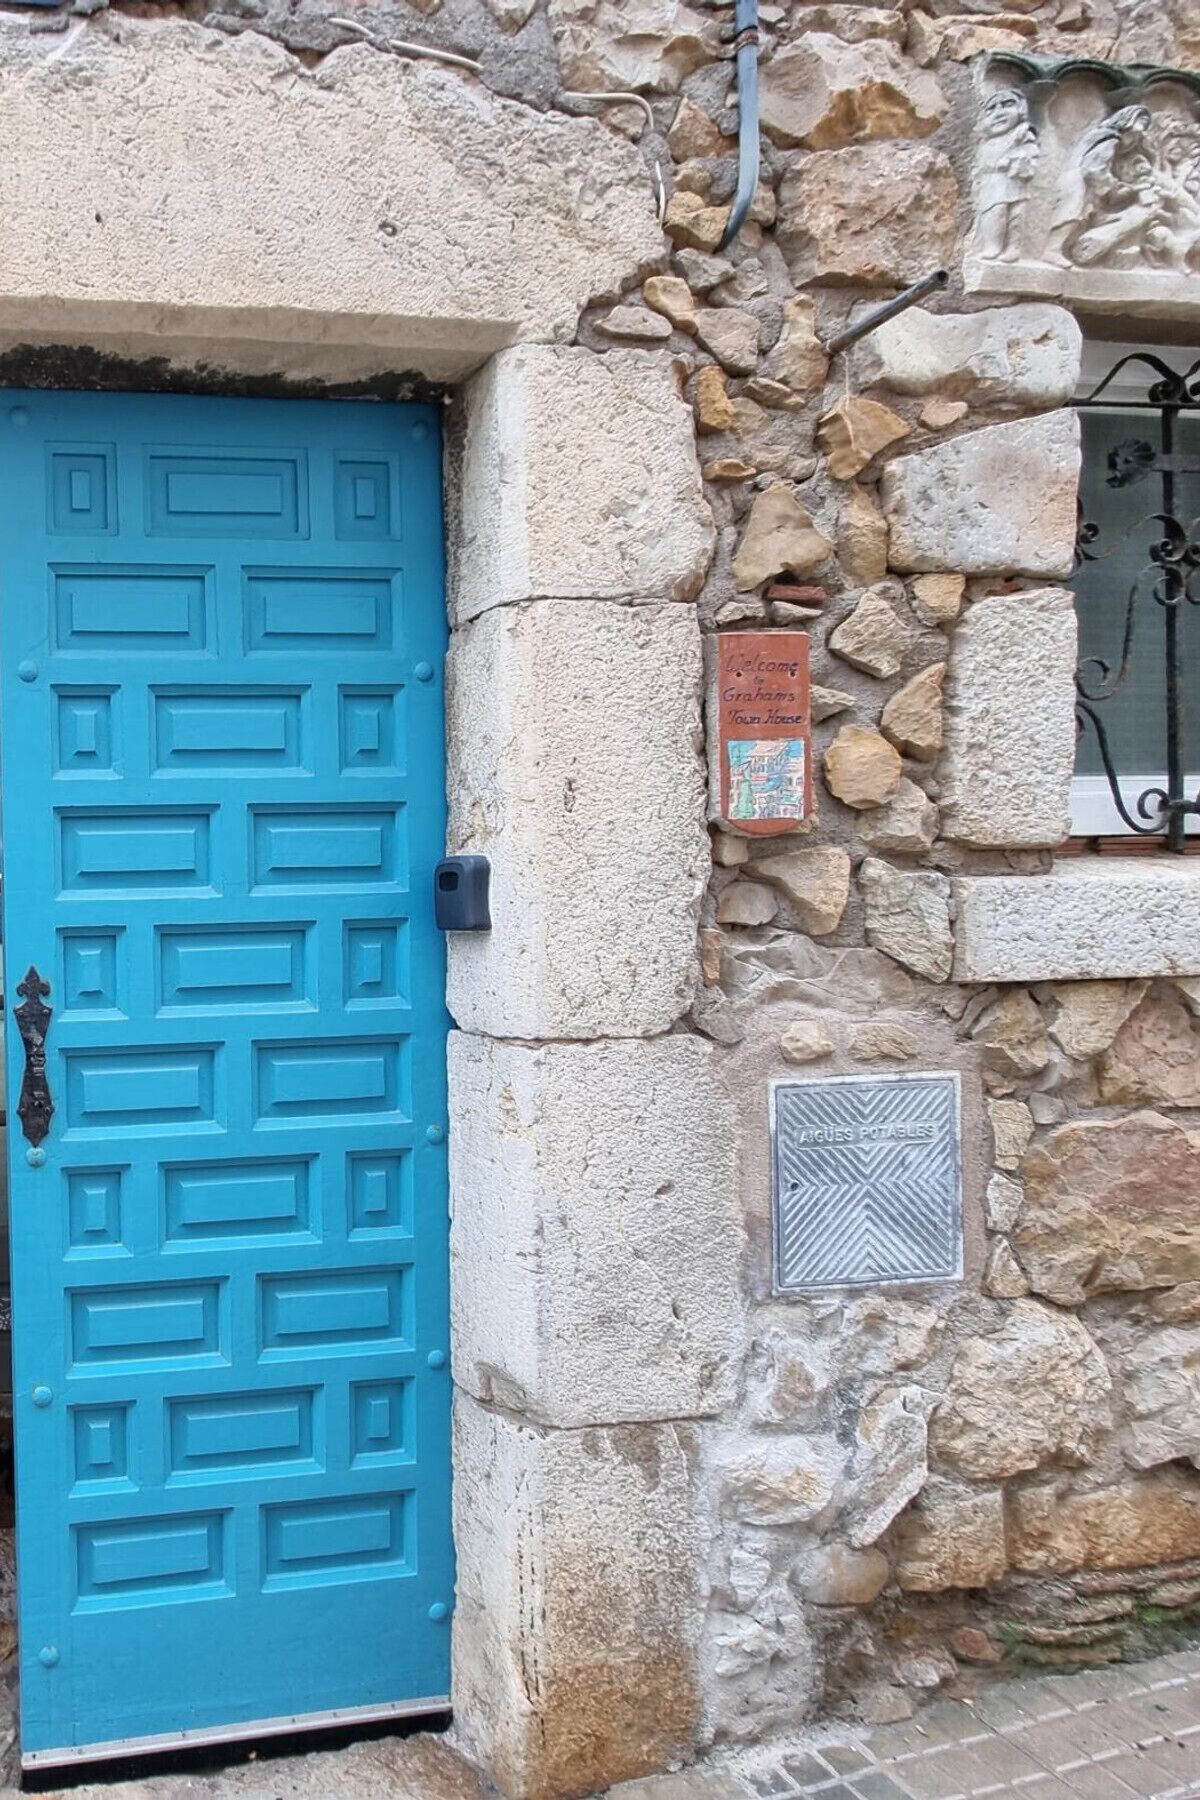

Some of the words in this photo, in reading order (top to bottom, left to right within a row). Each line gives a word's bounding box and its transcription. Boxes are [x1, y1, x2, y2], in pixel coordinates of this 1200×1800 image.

[726, 653, 798, 672] Welcome
[723, 687, 795, 702] Grahams
[728, 709, 761, 725] Town
[764, 708, 802, 725] House
[798, 1126, 853, 1143] AIGÜES
[859, 1123, 935, 1140] POTABLES
